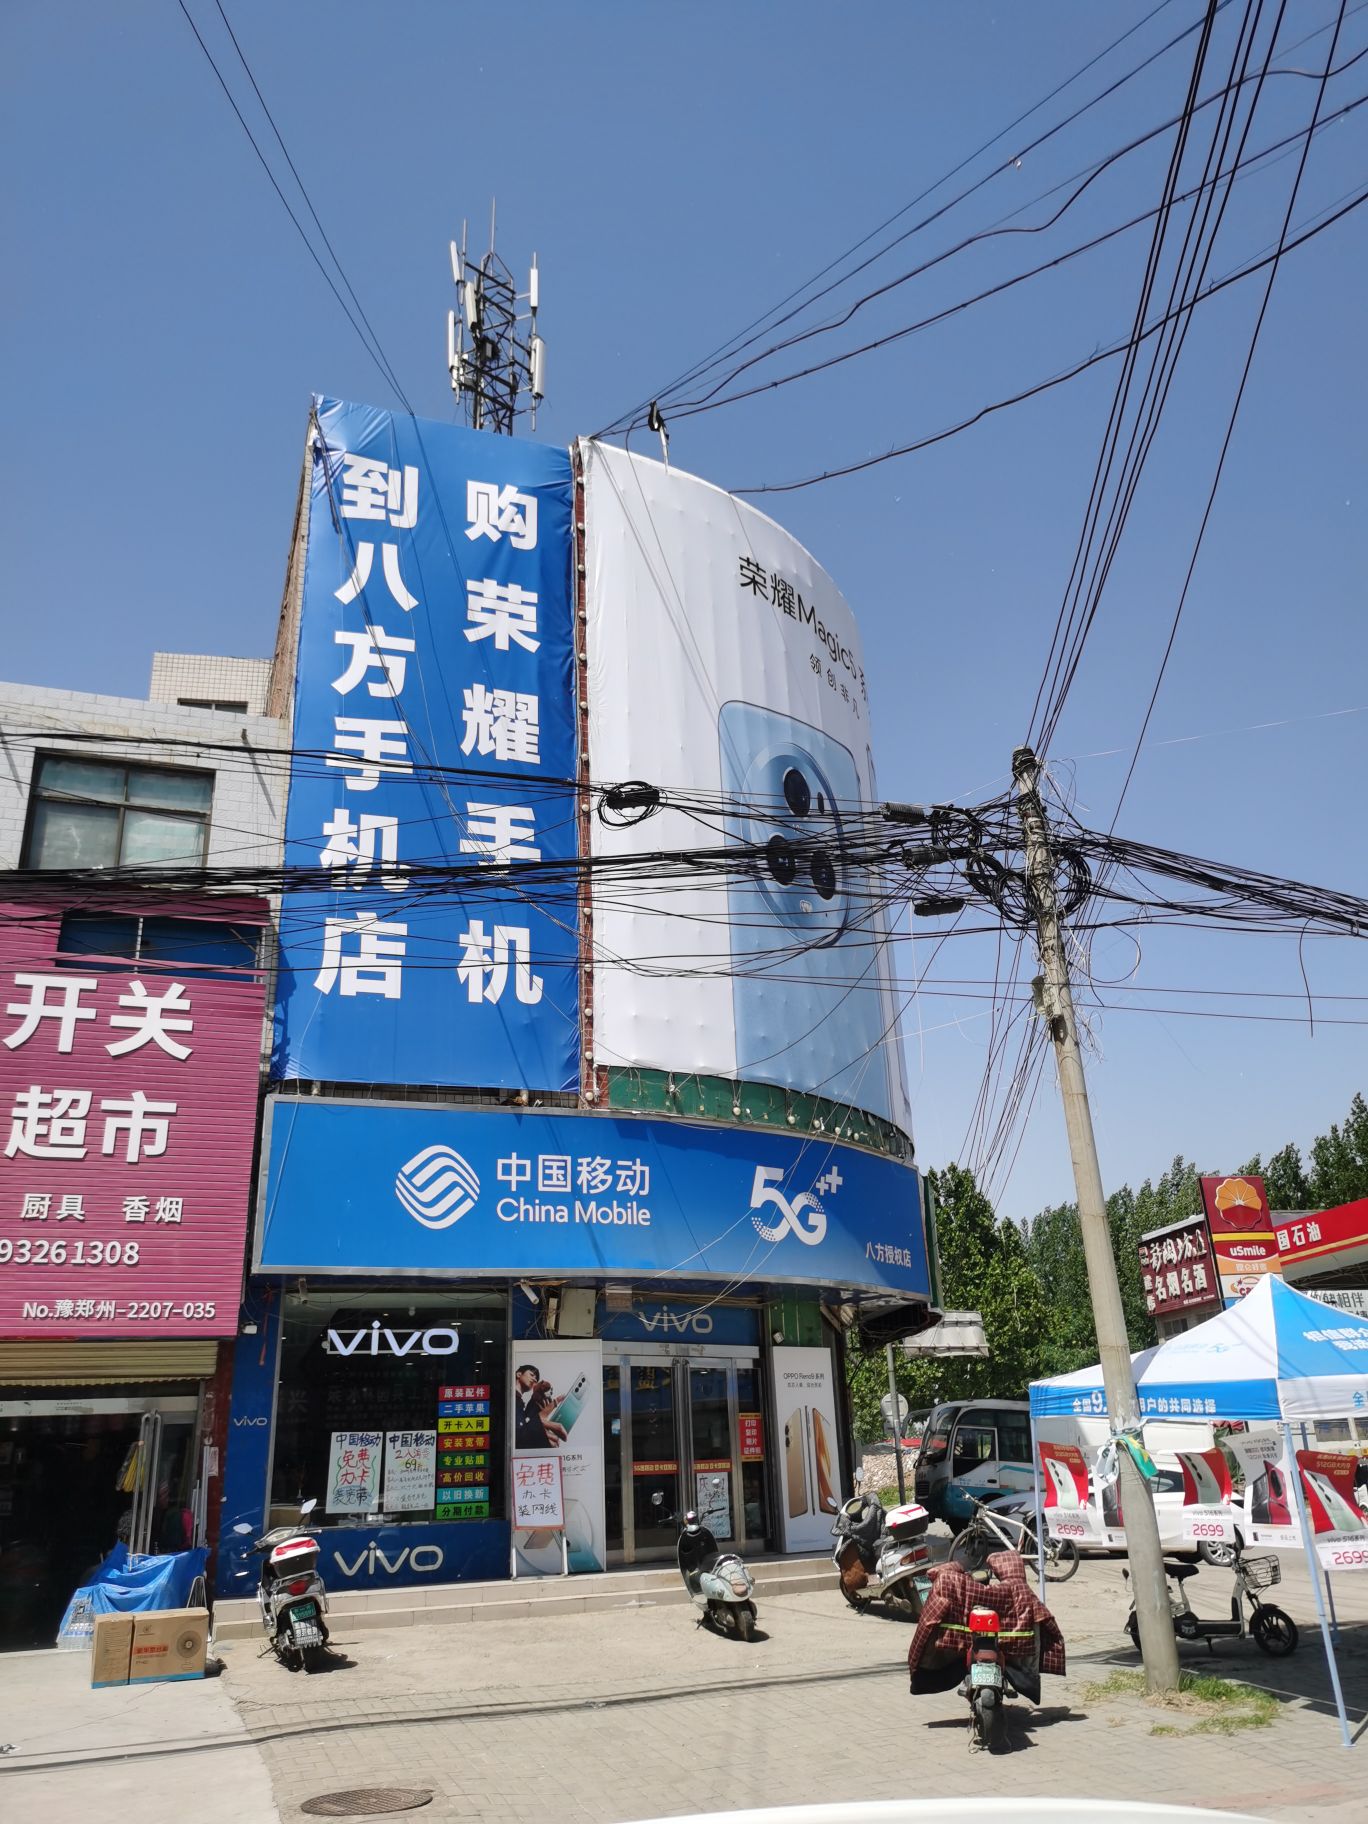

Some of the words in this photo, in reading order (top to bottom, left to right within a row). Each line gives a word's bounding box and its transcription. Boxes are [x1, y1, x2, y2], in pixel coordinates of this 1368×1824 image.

[738, 556, 870, 702] 荣耀Magic5系
[312, 453, 420, 1000] 到八方手机店
[458, 479, 545, 1005] 购荣耀手机
[2, 972, 195, 1061] 开关
[4, 1085, 178, 1164] 超市
[496, 1151, 650, 1197] 中国移动
[20, 1193, 86, 1221] 厨具
[122, 1196, 184, 1224] 香烟
[496, 1197, 569, 1224] China
[575, 1200, 651, 1226] Mobile
[1276, 1221, 1322, 1252] 国石油
[0, 1237, 140, 1266] 93261308
[865, 1241, 912, 1269] 八方授权店
[1229, 1245, 1266, 1257] uSmile
[1155, 1263, 1208, 1301] 名烟名酒
[637, 1305, 713, 1335] vivo
[327, 1320, 459, 1356] vivo
[443, 1387, 485, 1399] 原装配件
[443, 1403, 485, 1414] 二手苹果
[233, 1415, 268, 1427] vivo
[443, 1420, 484, 1430] 开卡入网
[335, 1433, 382, 1450] 中国移动
[388, 1432, 435, 1449] 中国移动
[443, 1437, 485, 1448] 安装宽带
[340, 1448, 371, 1470] 免费
[443, 1455, 485, 1466] 专业贴膜
[340, 1469, 370, 1485] 办卡
[443, 1472, 484, 1483] 高价回收
[516, 1463, 556, 1487] 免费
[442, 1489, 484, 1500] 以旧换新
[522, 1488, 553, 1500] 办卡
[442, 1506, 484, 1517] 分期付款
[518, 1503, 558, 1517] 装网线
[1056, 1523, 1085, 1536] 2699
[1192, 1523, 1224, 1537] 2699
[333, 1541, 444, 1576] vivo
[1331, 1550, 1368, 1565] 2699
